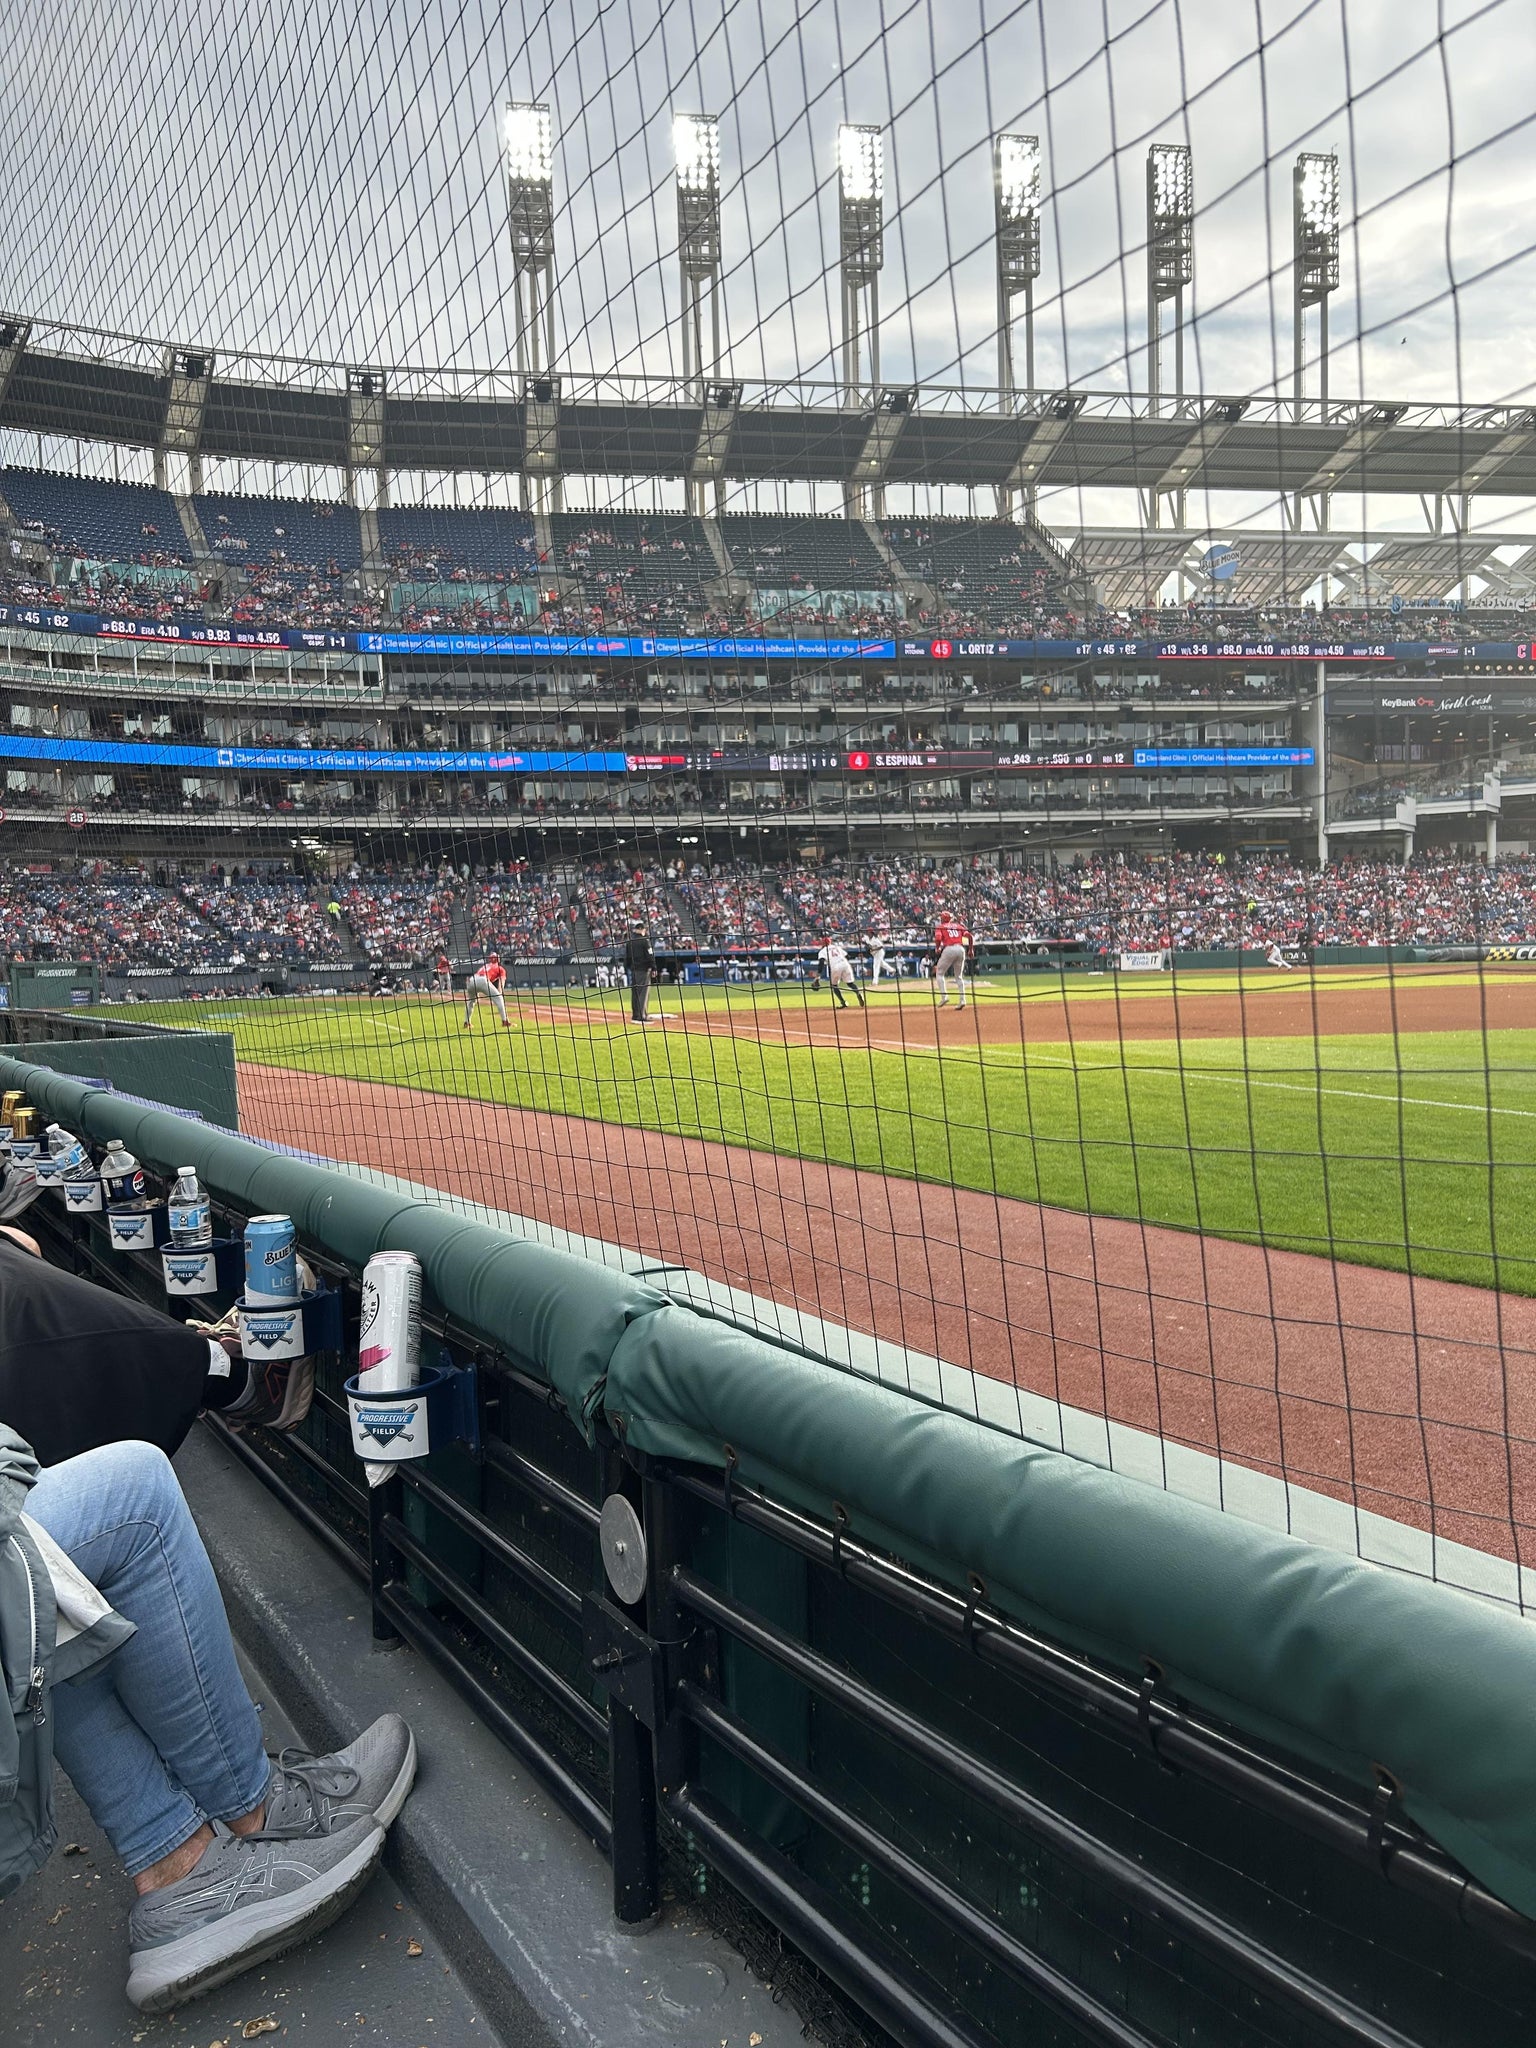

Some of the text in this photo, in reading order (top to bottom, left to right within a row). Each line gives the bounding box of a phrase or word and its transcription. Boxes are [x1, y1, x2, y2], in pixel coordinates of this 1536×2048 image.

[1199, 551, 1240, 573] BLUE MOON
[25, 611, 40, 625] 45
[54, 615, 69, 628] 62
[110, 621, 136, 634] 68.0
[141, 626, 155, 635] ERA
[157, 625, 180, 638] 4.10
[207, 628, 231, 642] 9.93
[330, 636, 346, 648] 1-1
[423, 639, 448, 649] Clinic
[456, 639, 487, 650] Official
[490, 641, 531, 651] Healthcare
[581, 641, 594, 651] the
[724, 643, 754, 654] Official
[756, 644, 795, 654] Healthcare
[799, 644, 829, 654] Provider
[842, 644, 855, 654] the
[935, 643, 949, 655] 45
[959, 643, 995, 655] L. ORTIZ
[1081, 644, 1091, 655] 17
[1103, 644, 1115, 655] 45
[1125, 644, 1136, 655] 62
[1167, 644, 1177, 655] 13
[1193, 644, 1208, 655] 3-6
[1223, 644, 1242, 655] 68.0
[1245, 647, 1256, 655] ERA
[1256, 644, 1274, 655] 4.10
[1291, 645, 1309, 655] 9.93
[1328, 645, 1344, 656] 4.50
[1368, 645, 1385, 656] 1.43
[1464, 646, 1476, 656] 1-1
[1381, 693, 1492, 711] KeyBank North Coast
[282, 754, 307, 764] Clinic
[317, 755, 354, 765] Official
[457, 758, 467, 767] of
[470, 758, 486, 767] the
[855, 755, 863, 766] 4
[876, 755, 885, 766] S.
[886, 755, 923, 766] ESPINAL
[1085, 753, 1092, 764] 0
[1114, 753, 1124, 764] 12
[1280, 753, 1290, 761] the
[69, 812, 84, 823] 25
[1150, 955, 1159, 965] IT
[265, 1247, 290, 1266] BLUE
[272, 1275, 297, 1289] LIG
[360, 1301, 377, 1336] ELTZER
[248, 1322, 289, 1330] PROGRESSIVE
[359, 1413, 409, 1423] PROGRESSIVE
[372, 1427, 396, 1435] FIELD
